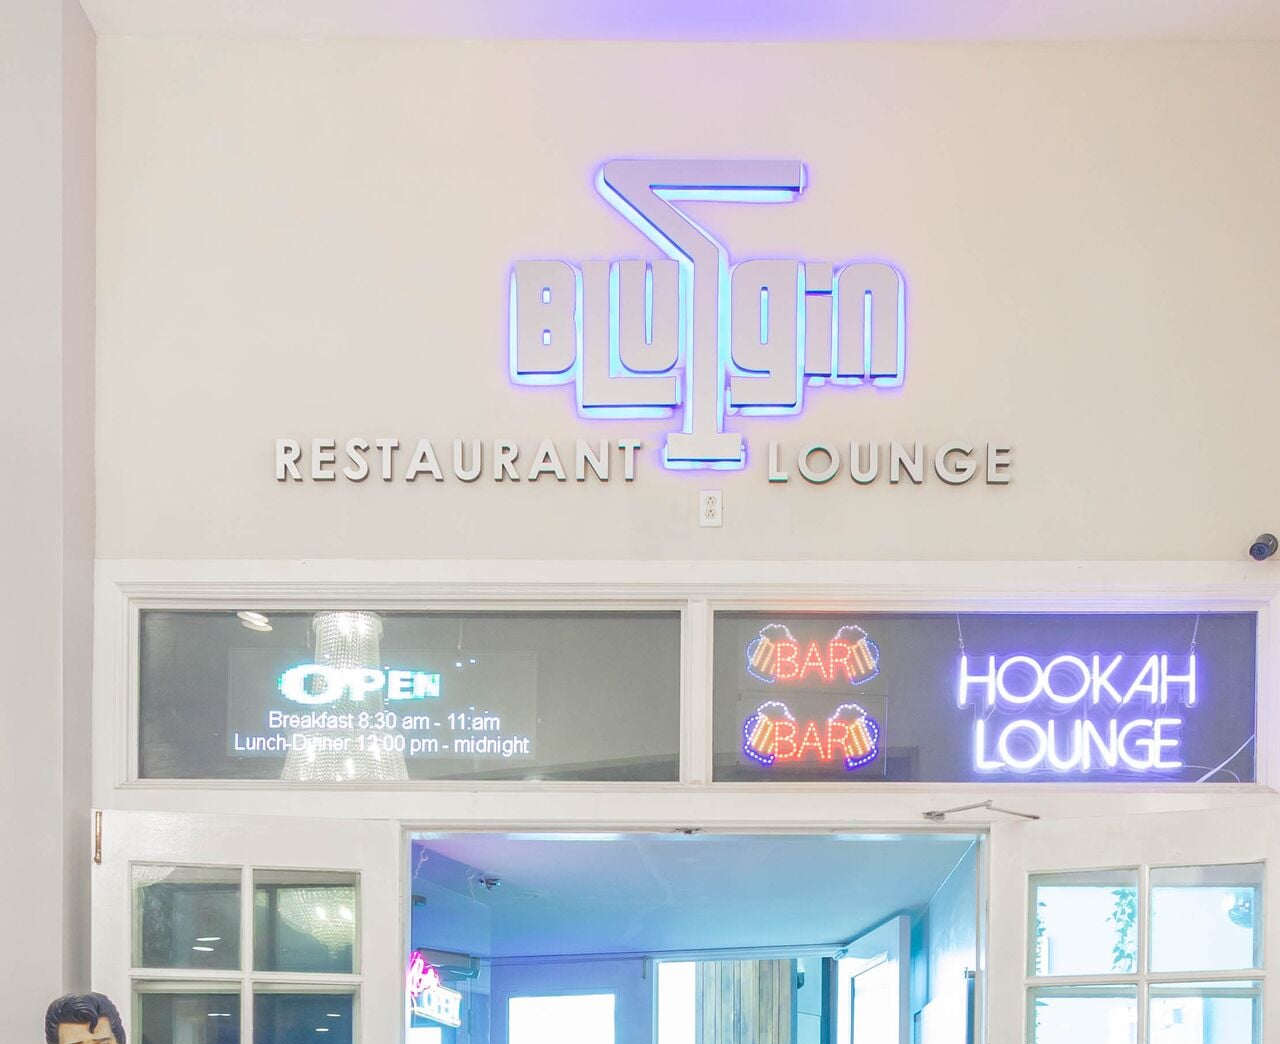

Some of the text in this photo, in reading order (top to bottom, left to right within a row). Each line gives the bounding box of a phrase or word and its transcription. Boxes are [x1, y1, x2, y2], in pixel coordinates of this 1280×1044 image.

[275, 436, 1016, 486] RESTAURANT LOUNGE
[773, 640, 850, 680] BAR
[959, 653, 1197, 706] HOOKAH
[279, 663, 441, 705] OPEN
[268, 711, 354, 730] Breakfast
[358, 712, 398, 730] 8:30
[402, 716, 430, 730] am
[773, 720, 850, 760] BAR
[234, 733, 350, 751] Lunch-Dinner
[357, 734, 405, 751] 12:00
[410, 738, 439, 755] pm
[454, 736, 530, 757] midnight
[974, 717, 1184, 770] LOUNGE
